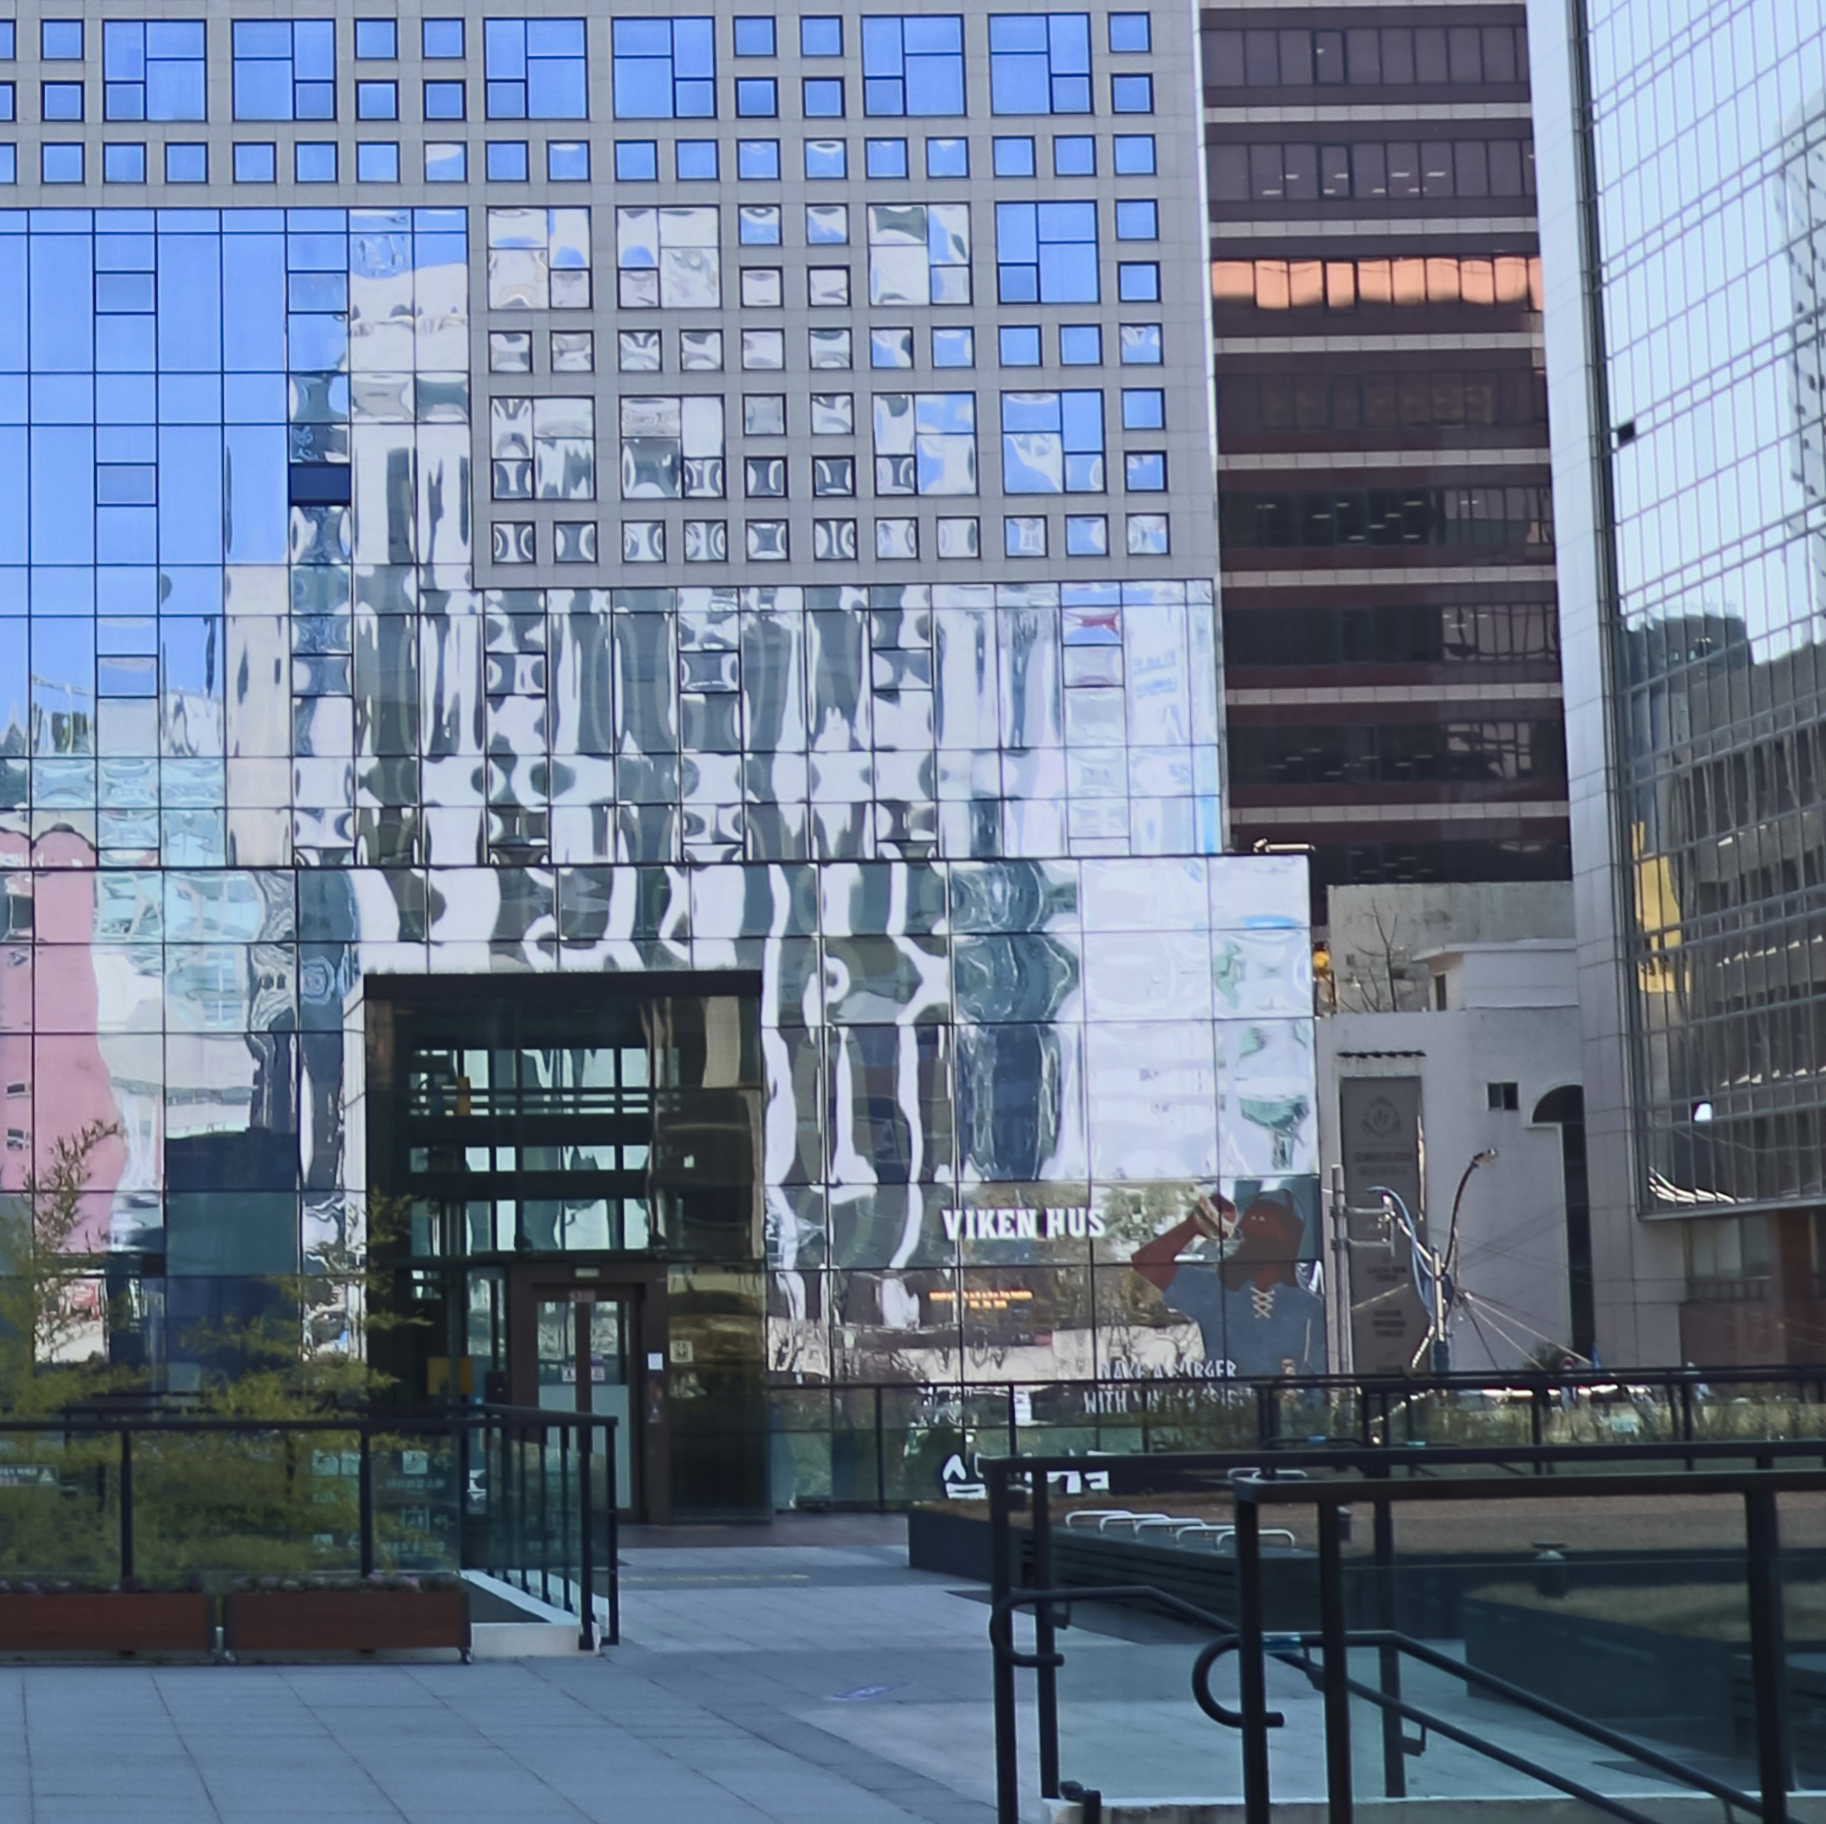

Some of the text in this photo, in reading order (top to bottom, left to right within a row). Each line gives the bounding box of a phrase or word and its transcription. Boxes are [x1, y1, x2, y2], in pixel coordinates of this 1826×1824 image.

[942, 1207, 1106, 1240] VIKEN HUS
[1084, 1391, 1128, 1413] WITH
